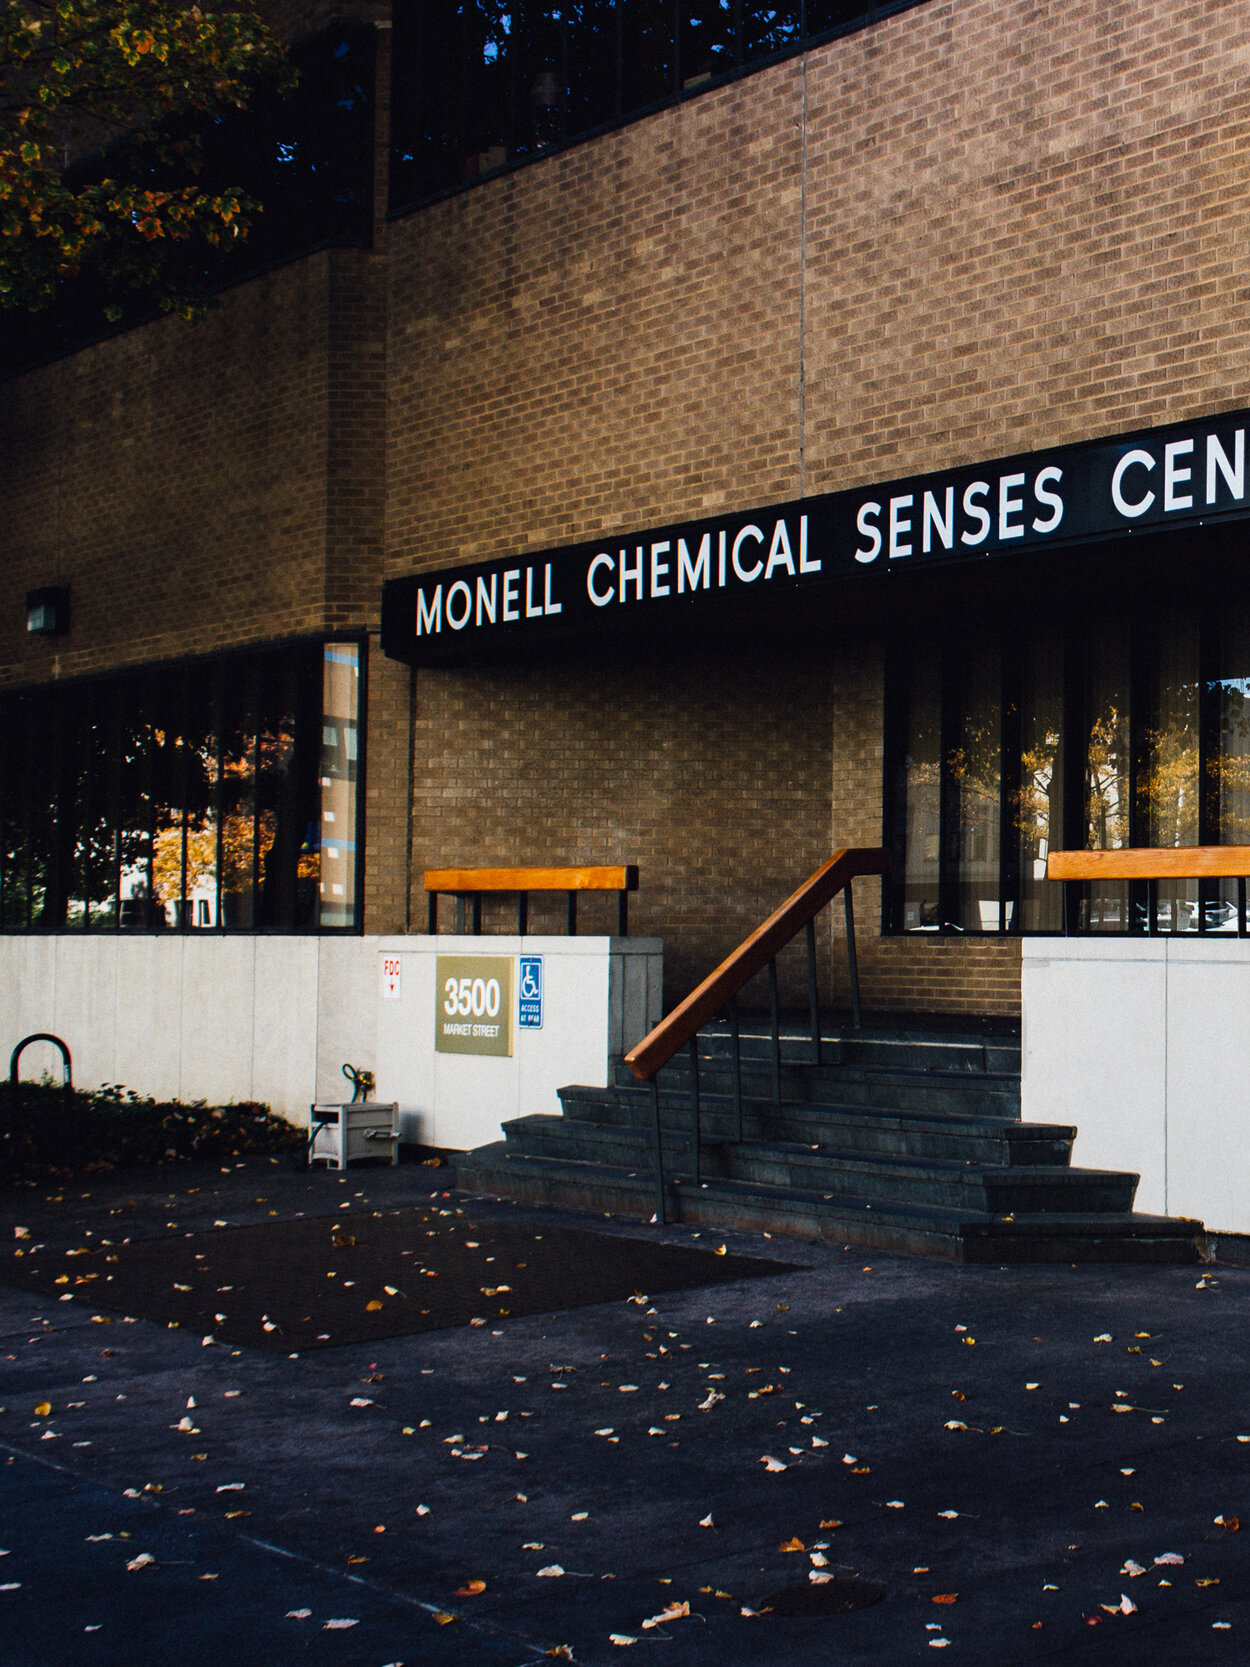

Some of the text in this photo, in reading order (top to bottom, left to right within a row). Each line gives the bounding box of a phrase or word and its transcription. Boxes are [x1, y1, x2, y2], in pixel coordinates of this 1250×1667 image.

[416, 561, 562, 637] MONELL
[587, 514, 822, 608] CHEMICAL
[854, 465, 1065, 564] SENSES
[384, 960, 400, 975] FDC
[444, 977, 501, 1017] 3500
[520, 1004, 539, 1013] ACCESS
[443, 1023, 500, 1037] MARKET STREET
